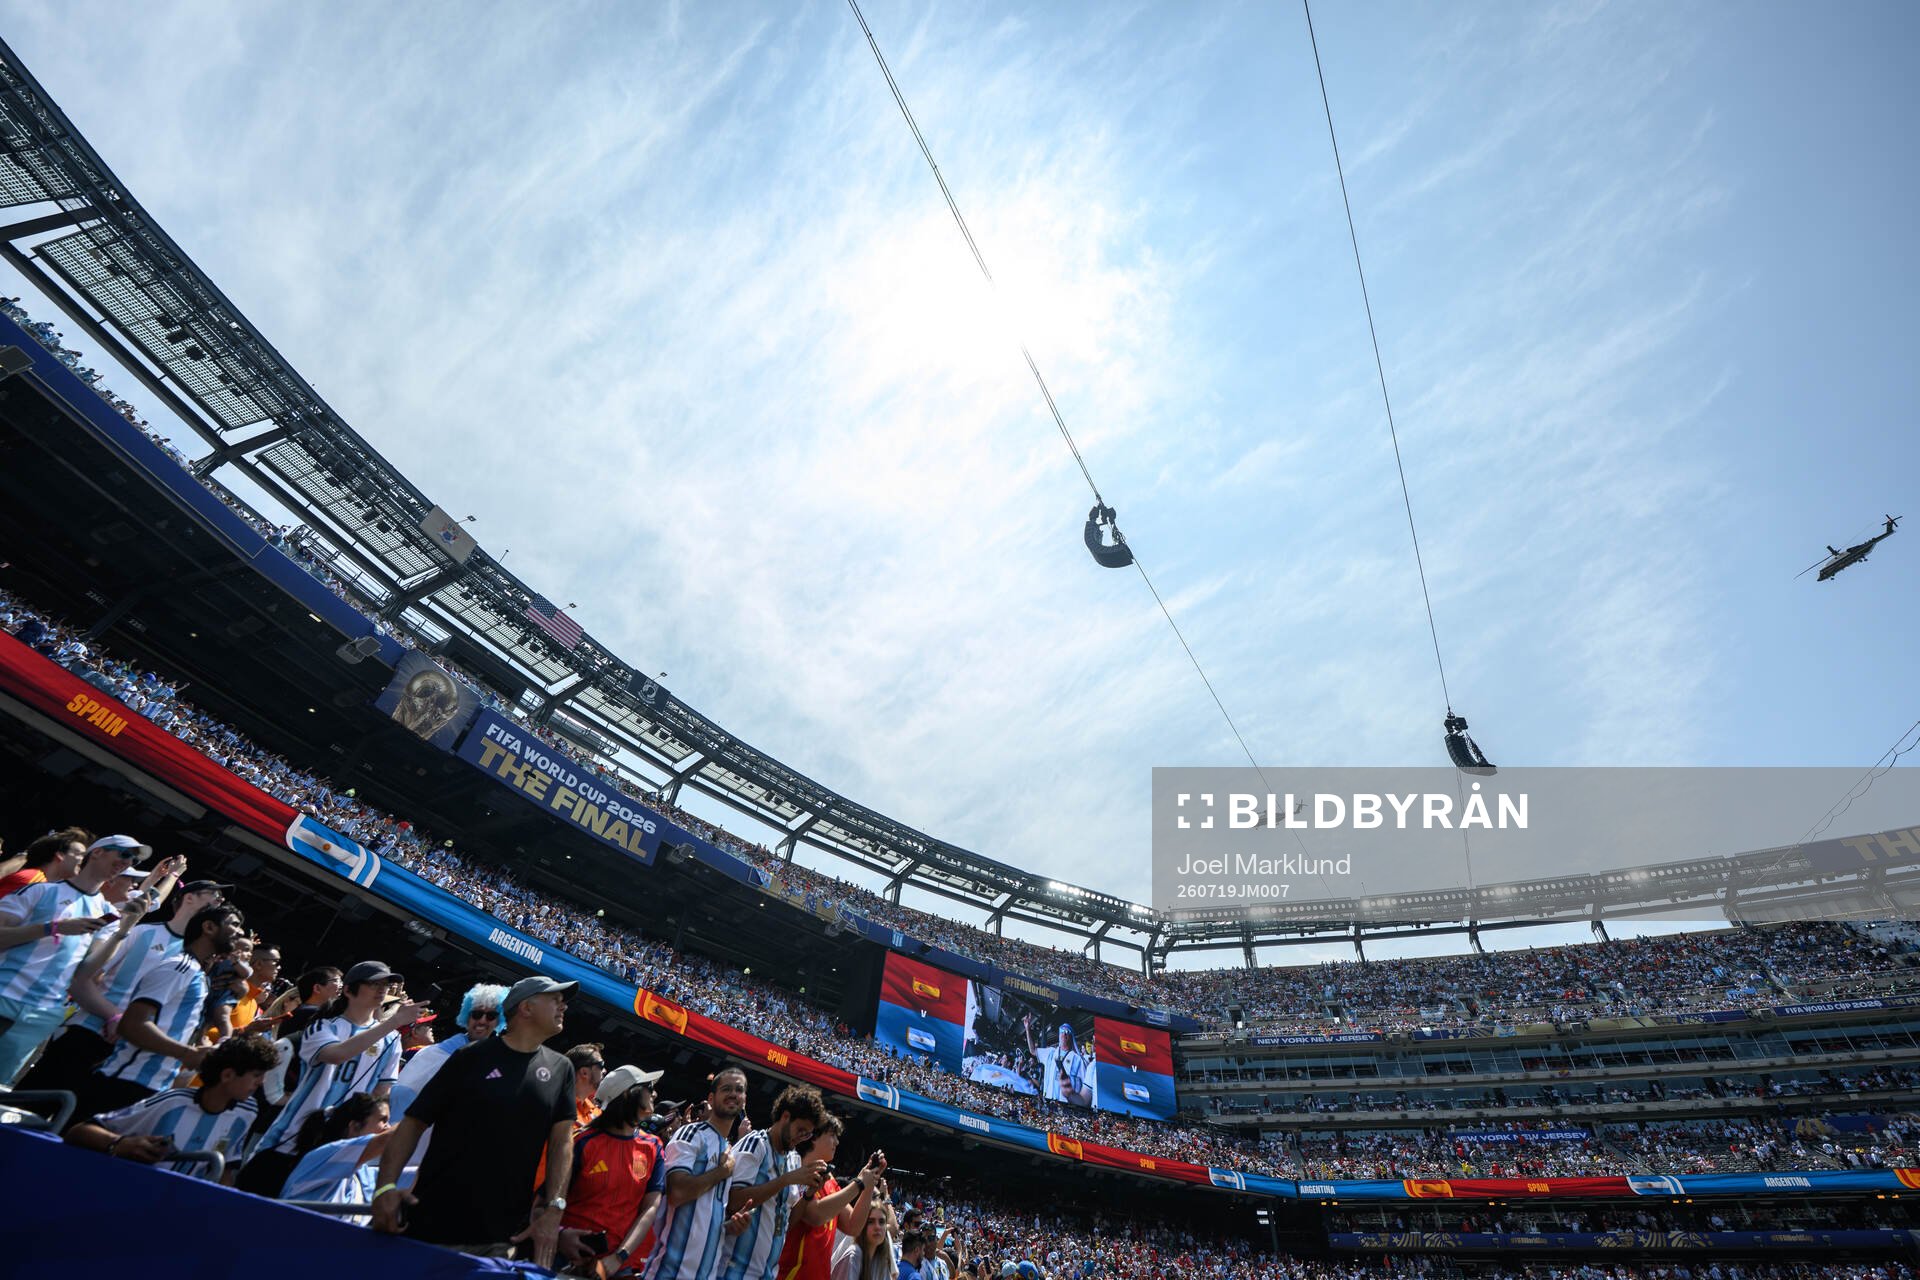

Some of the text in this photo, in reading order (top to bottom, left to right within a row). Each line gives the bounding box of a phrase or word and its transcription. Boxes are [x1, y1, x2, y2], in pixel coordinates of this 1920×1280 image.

[66, 693, 129, 738] SPAIN
[485, 722, 658, 834] FIFA WORLD CUP 2026
[478, 736, 648, 858] THE FINAL
[488, 927, 544, 966] ARGENTINA
[1785, 1006, 1804, 1014] FIFA
[1803, 1004, 1834, 1013] WORLD
[1834, 1002, 1851, 1010] CUP
[1852, 1000, 1882, 1009] 2026
[1257, 1034, 1375, 1045] NEW YORK NEW JERSEY
[767, 1049, 788, 1067] SPAIN
[959, 1114, 989, 1133] ARGENTINA
[1479, 1134, 1511, 1142] YORK
[1541, 1132, 1588, 1140] JERSEY
[1139, 1158, 1156, 1170] SPAIN
[1527, 1183, 1550, 1193] SPAIN
[1764, 1176, 1811, 1188] ARGENTINA
[1300, 1185, 1336, 1195] ARGENTINA
